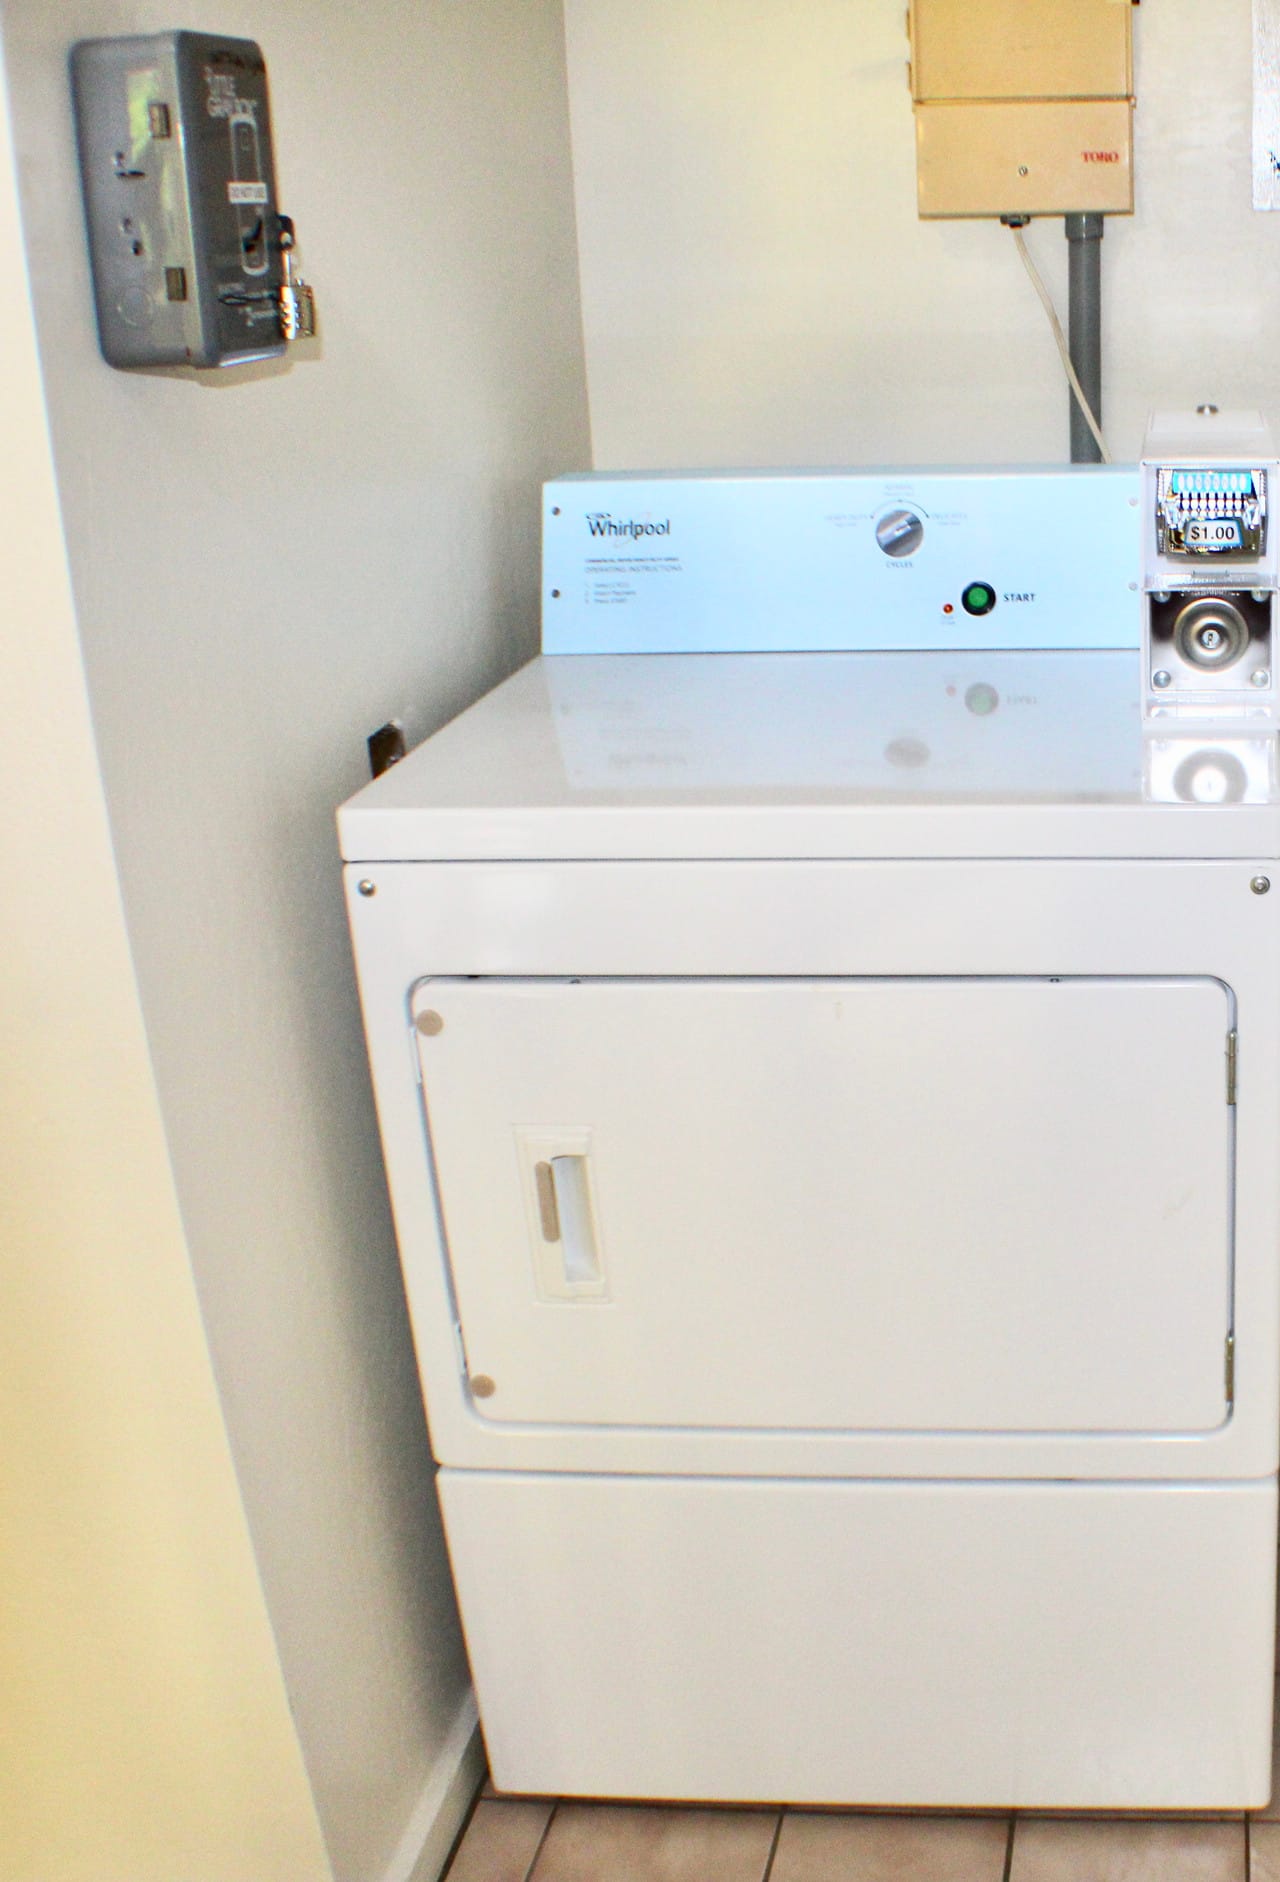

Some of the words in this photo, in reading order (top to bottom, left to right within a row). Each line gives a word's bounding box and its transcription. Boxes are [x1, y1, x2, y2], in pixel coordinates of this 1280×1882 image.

[1081, 151, 1119, 163] TORO
[588, 519, 671, 541] Whirlpool
[1190, 526, 1235, 540] $1.00
[1003, 593, 1036, 602] START
